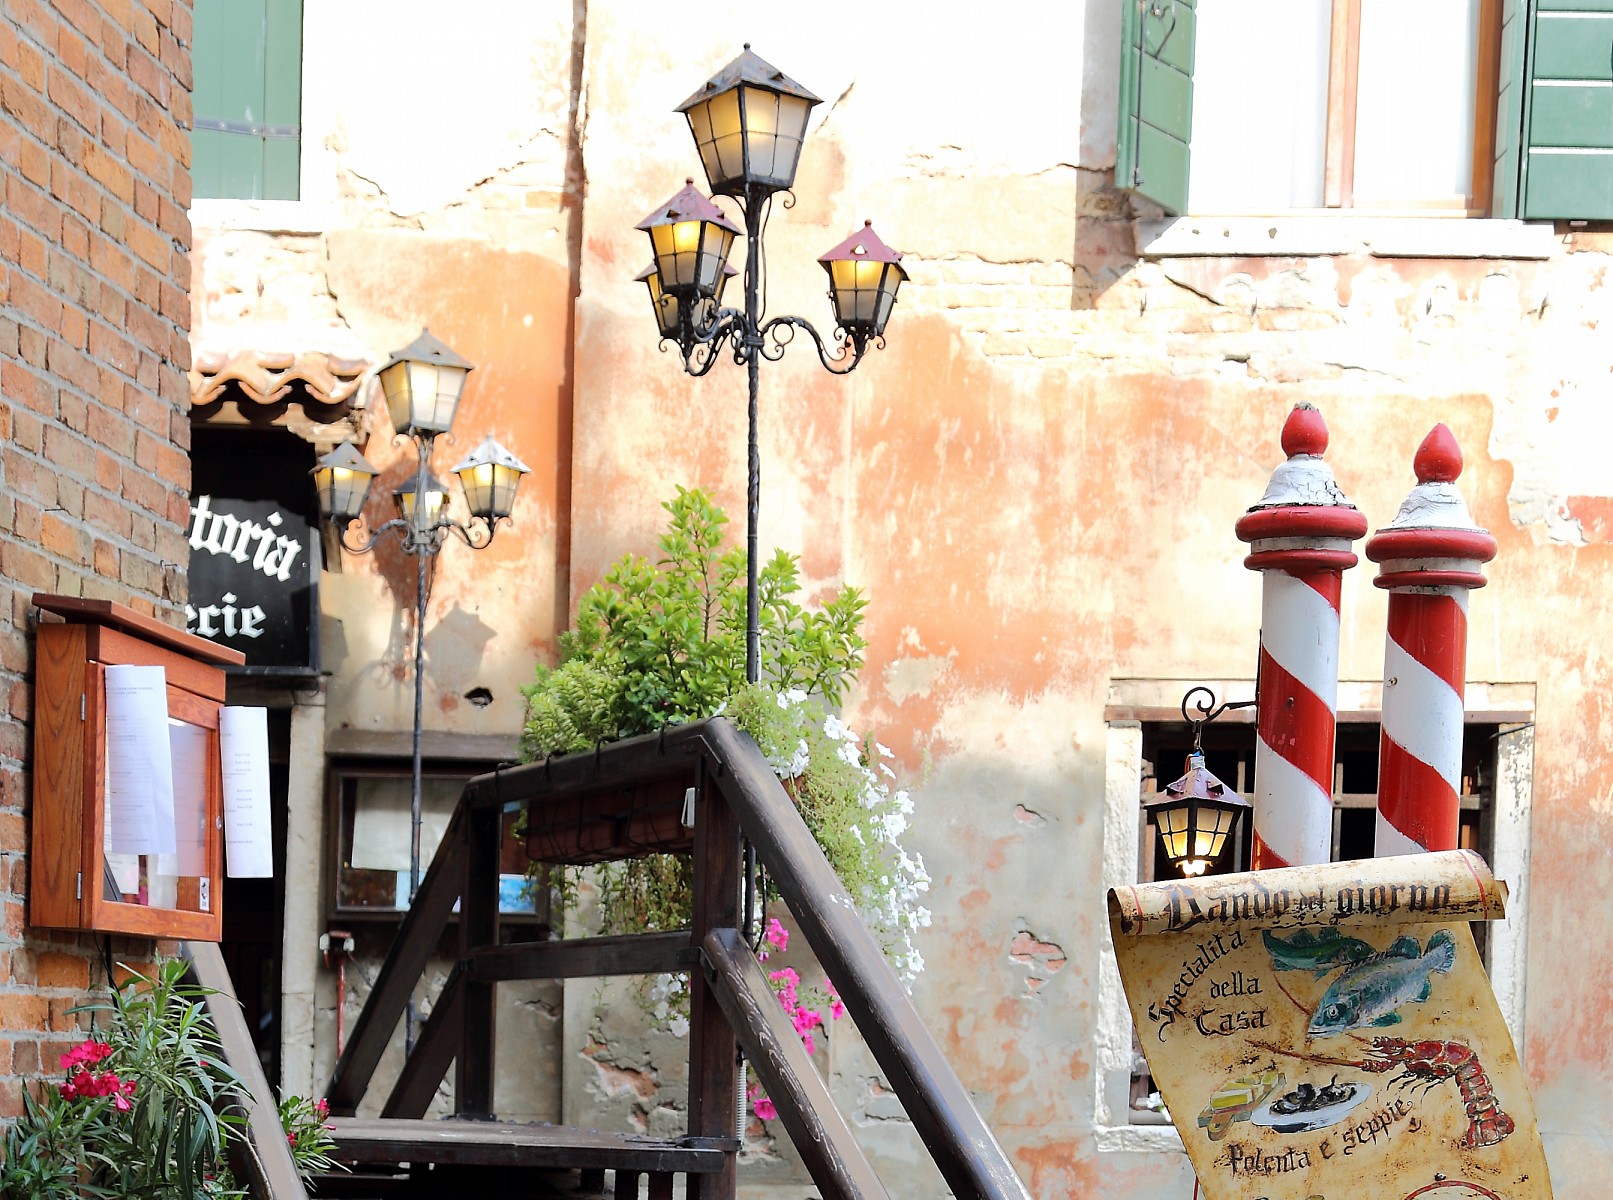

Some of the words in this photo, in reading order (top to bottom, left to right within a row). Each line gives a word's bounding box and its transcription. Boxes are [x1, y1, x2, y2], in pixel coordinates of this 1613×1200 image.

[1331, 879, 1452, 925] giorno
[1210, 971, 1263, 999] della
[1196, 1007, 1270, 1036] Casa
[1228, 1143, 1311, 1178] Polenta
